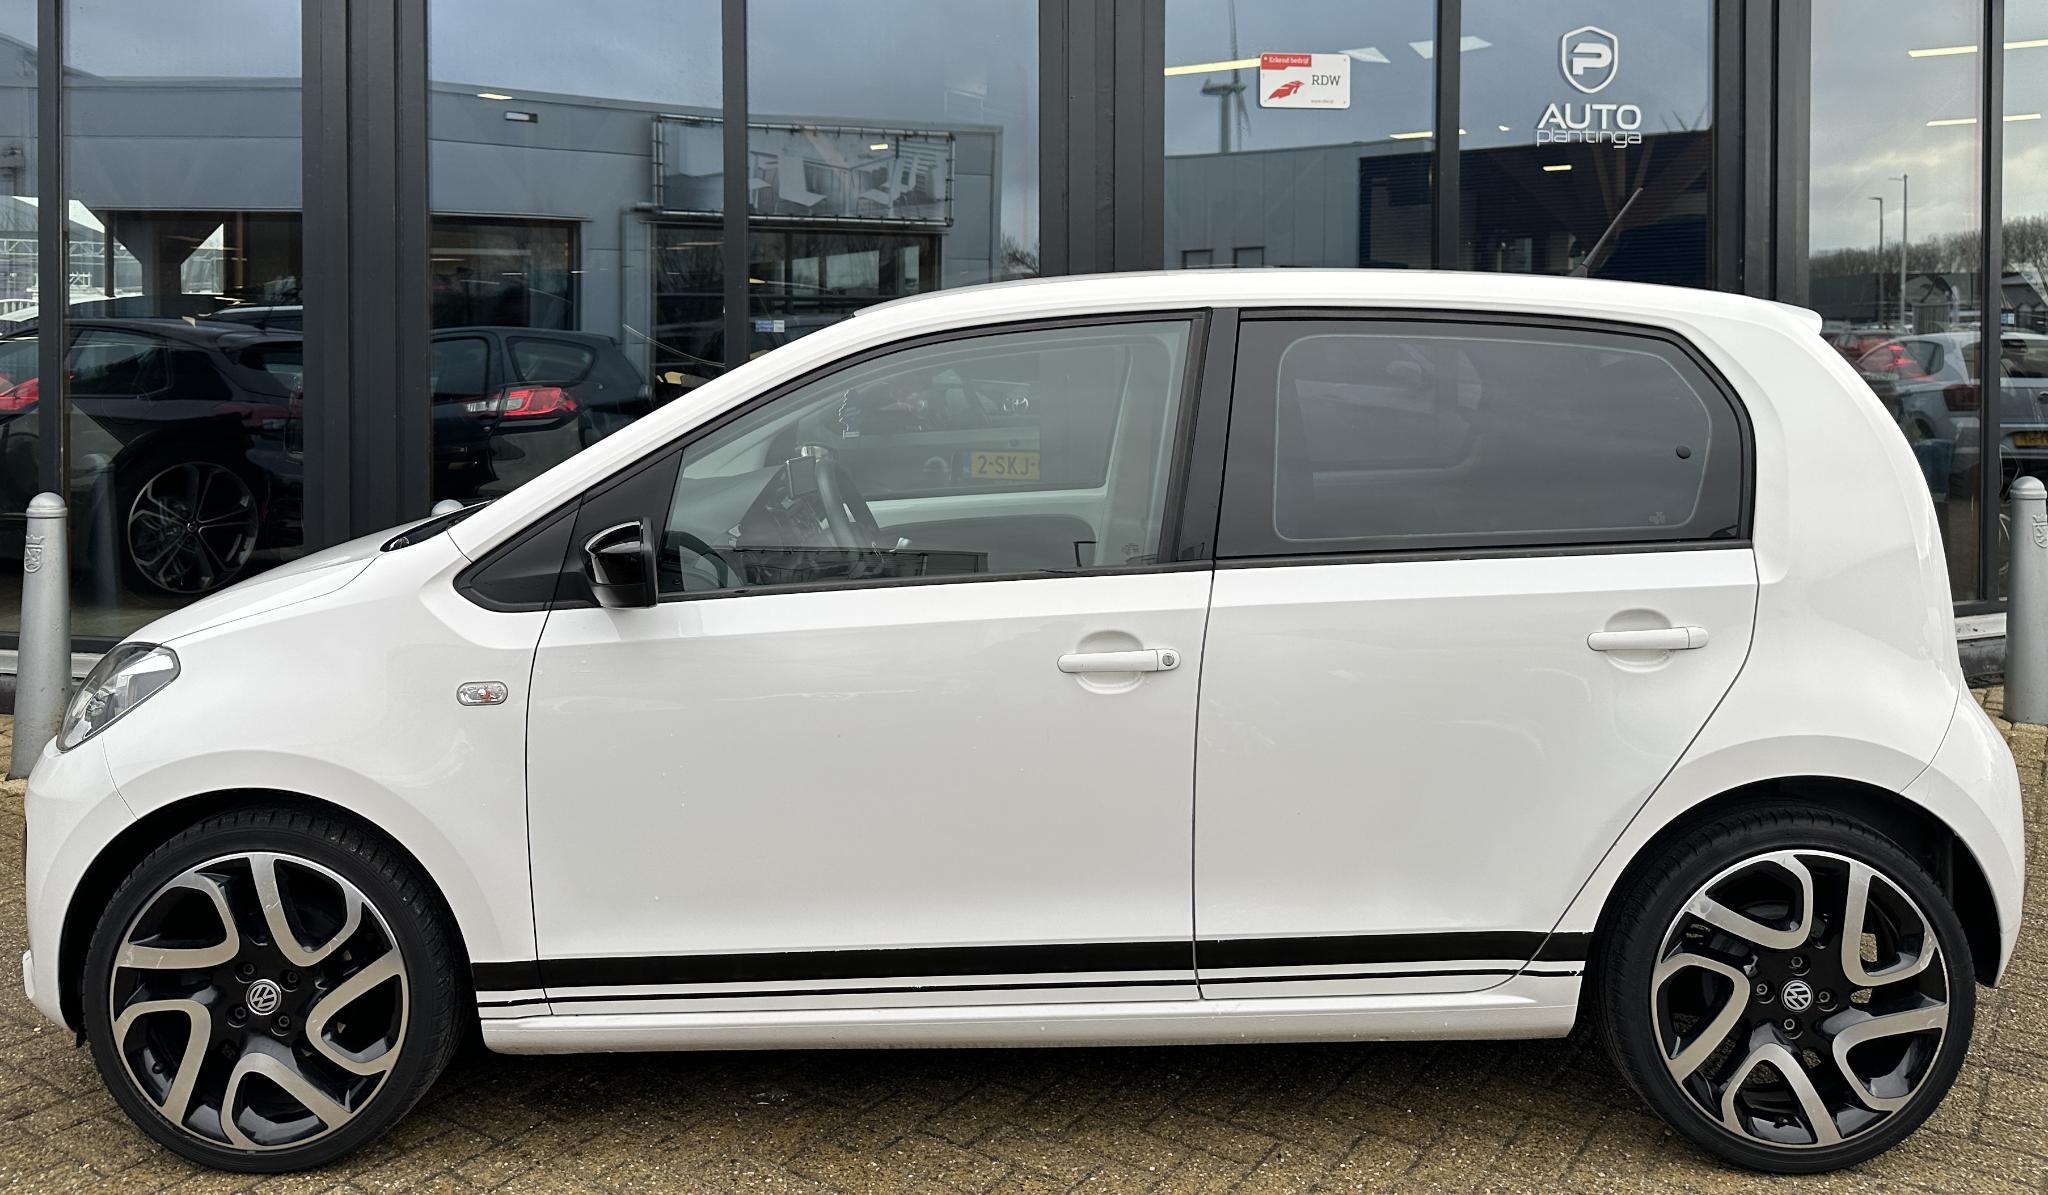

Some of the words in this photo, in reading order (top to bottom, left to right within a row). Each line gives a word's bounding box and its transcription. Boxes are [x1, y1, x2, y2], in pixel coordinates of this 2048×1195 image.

[1573, 43, 1612, 75] P
[1312, 75, 1341, 86] RDW
[1537, 103, 1641, 130] AUTO
[1536, 127, 1642, 148] plantinga
